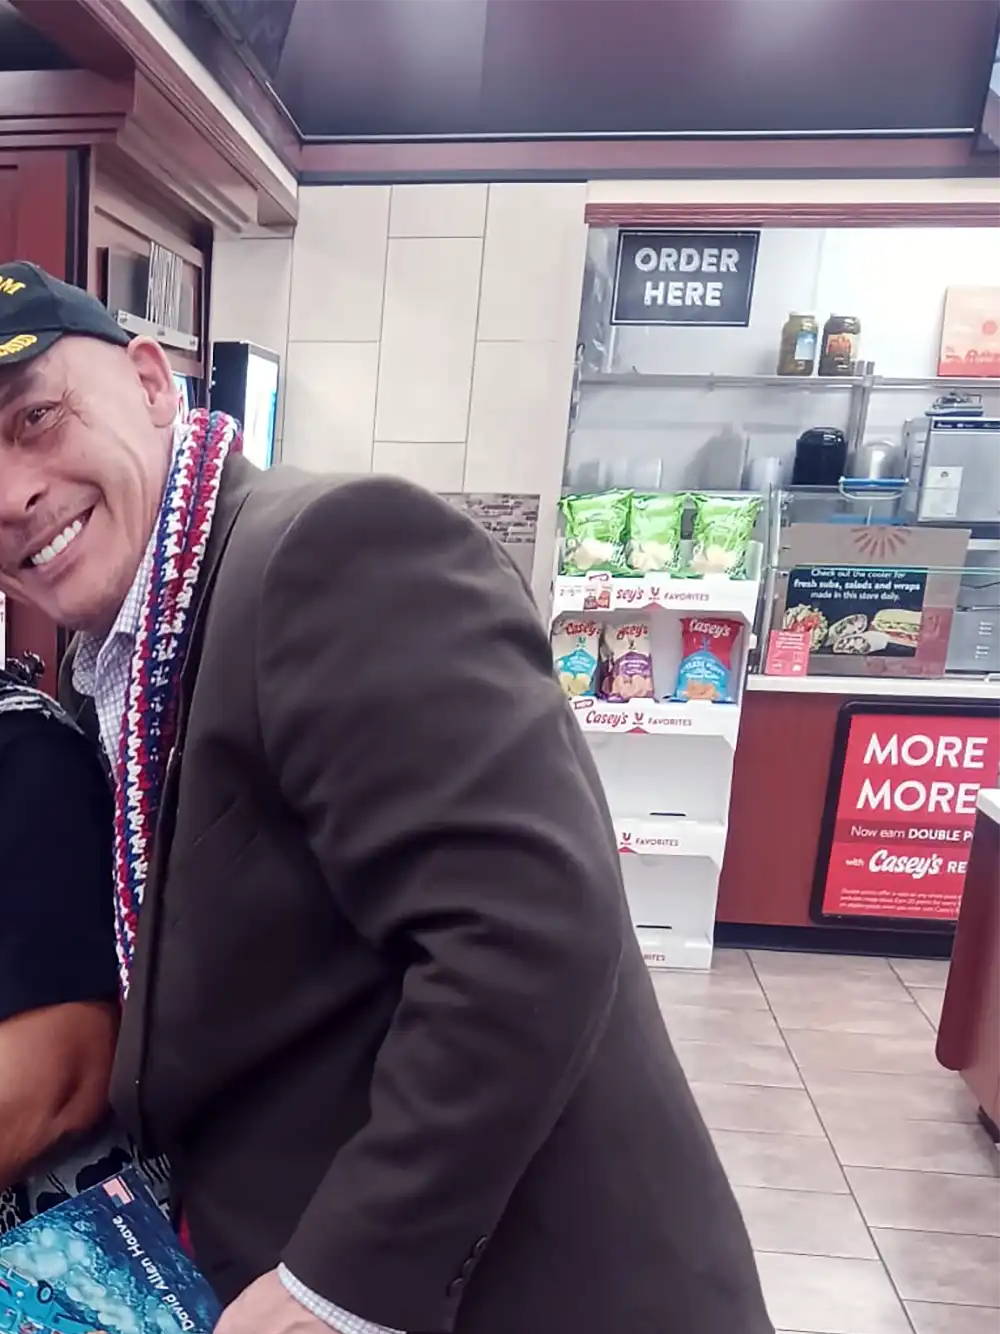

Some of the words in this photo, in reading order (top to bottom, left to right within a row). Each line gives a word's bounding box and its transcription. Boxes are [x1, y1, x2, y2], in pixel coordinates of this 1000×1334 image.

[634, 247, 740, 273] ORDER
[643, 281, 724, 308] HERE
[616, 587, 644, 601] sey's
[663, 592, 710, 602] FAVORITES
[793, 579, 817, 588] fresh
[844, 581, 872, 590] salads
[874, 581, 891, 590] and
[893, 583, 921, 592] wraps
[810, 590, 832, 599] made
[833, 591, 842, 599] in
[843, 591, 857, 599] this
[858, 592, 879, 600] store
[689, 619, 731, 639] Casey's
[586, 710, 628, 728] Casey's
[648, 717, 692, 727] FAVORITES
[863, 732, 988, 769] MORE
[856, 778, 981, 814] MORE
[635, 837, 679, 847] FAVORITES
[851, 825, 877, 837] Now
[879, 829, 905, 839] earn
[908, 828, 961, 841] DOUBLE
[845, 858, 864, 867] with
[868, 849, 944, 880] Casey's
[112, 1215, 145, 1257] Haave
[141, 1257, 170, 1290] Allen
[161, 1293, 195, 1331] David
